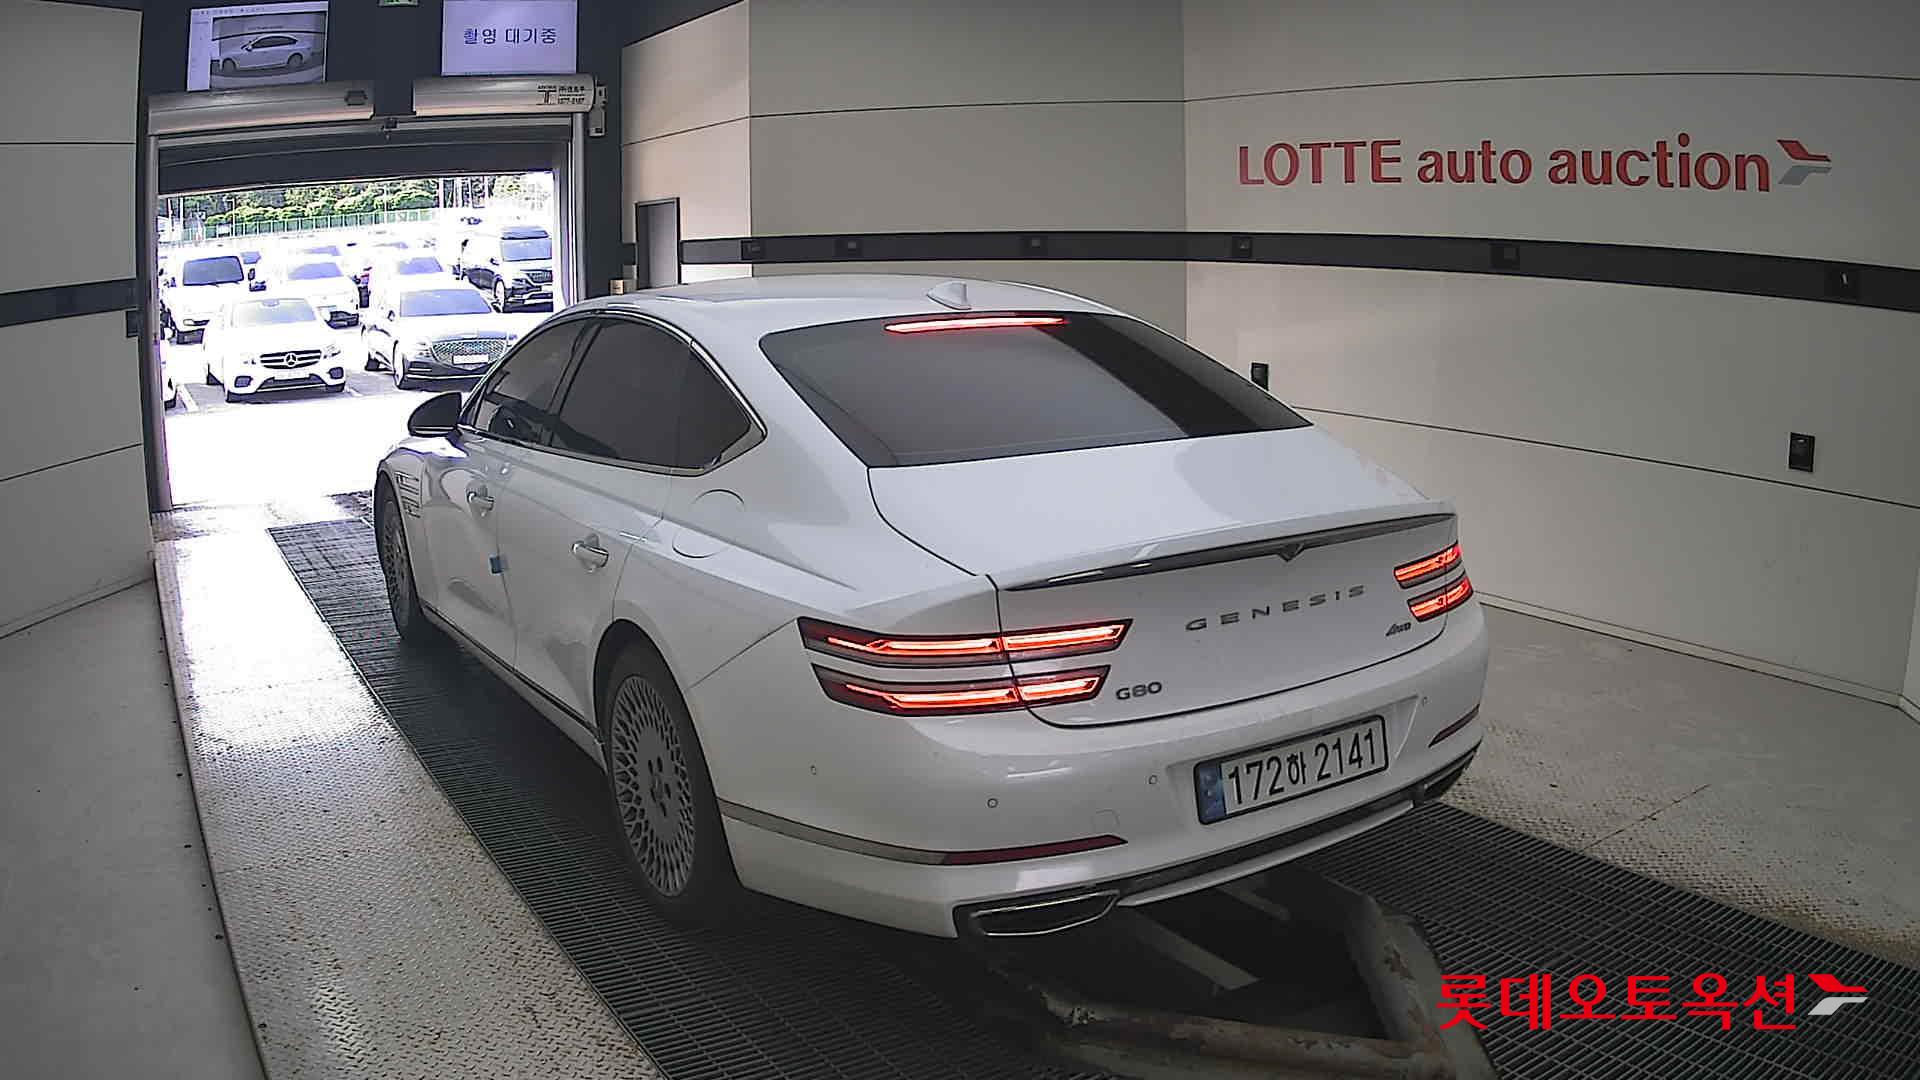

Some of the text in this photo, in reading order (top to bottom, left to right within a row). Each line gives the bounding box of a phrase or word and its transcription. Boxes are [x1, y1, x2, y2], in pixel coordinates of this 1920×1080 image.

[505, 28, 557, 44] 대기중
[1239, 132, 1771, 193] LOTTE auto auction
[1185, 585, 1365, 632] GENESIS
[1116, 681, 1163, 700] G80
[1228, 728, 1375, 805] 172하 2141
